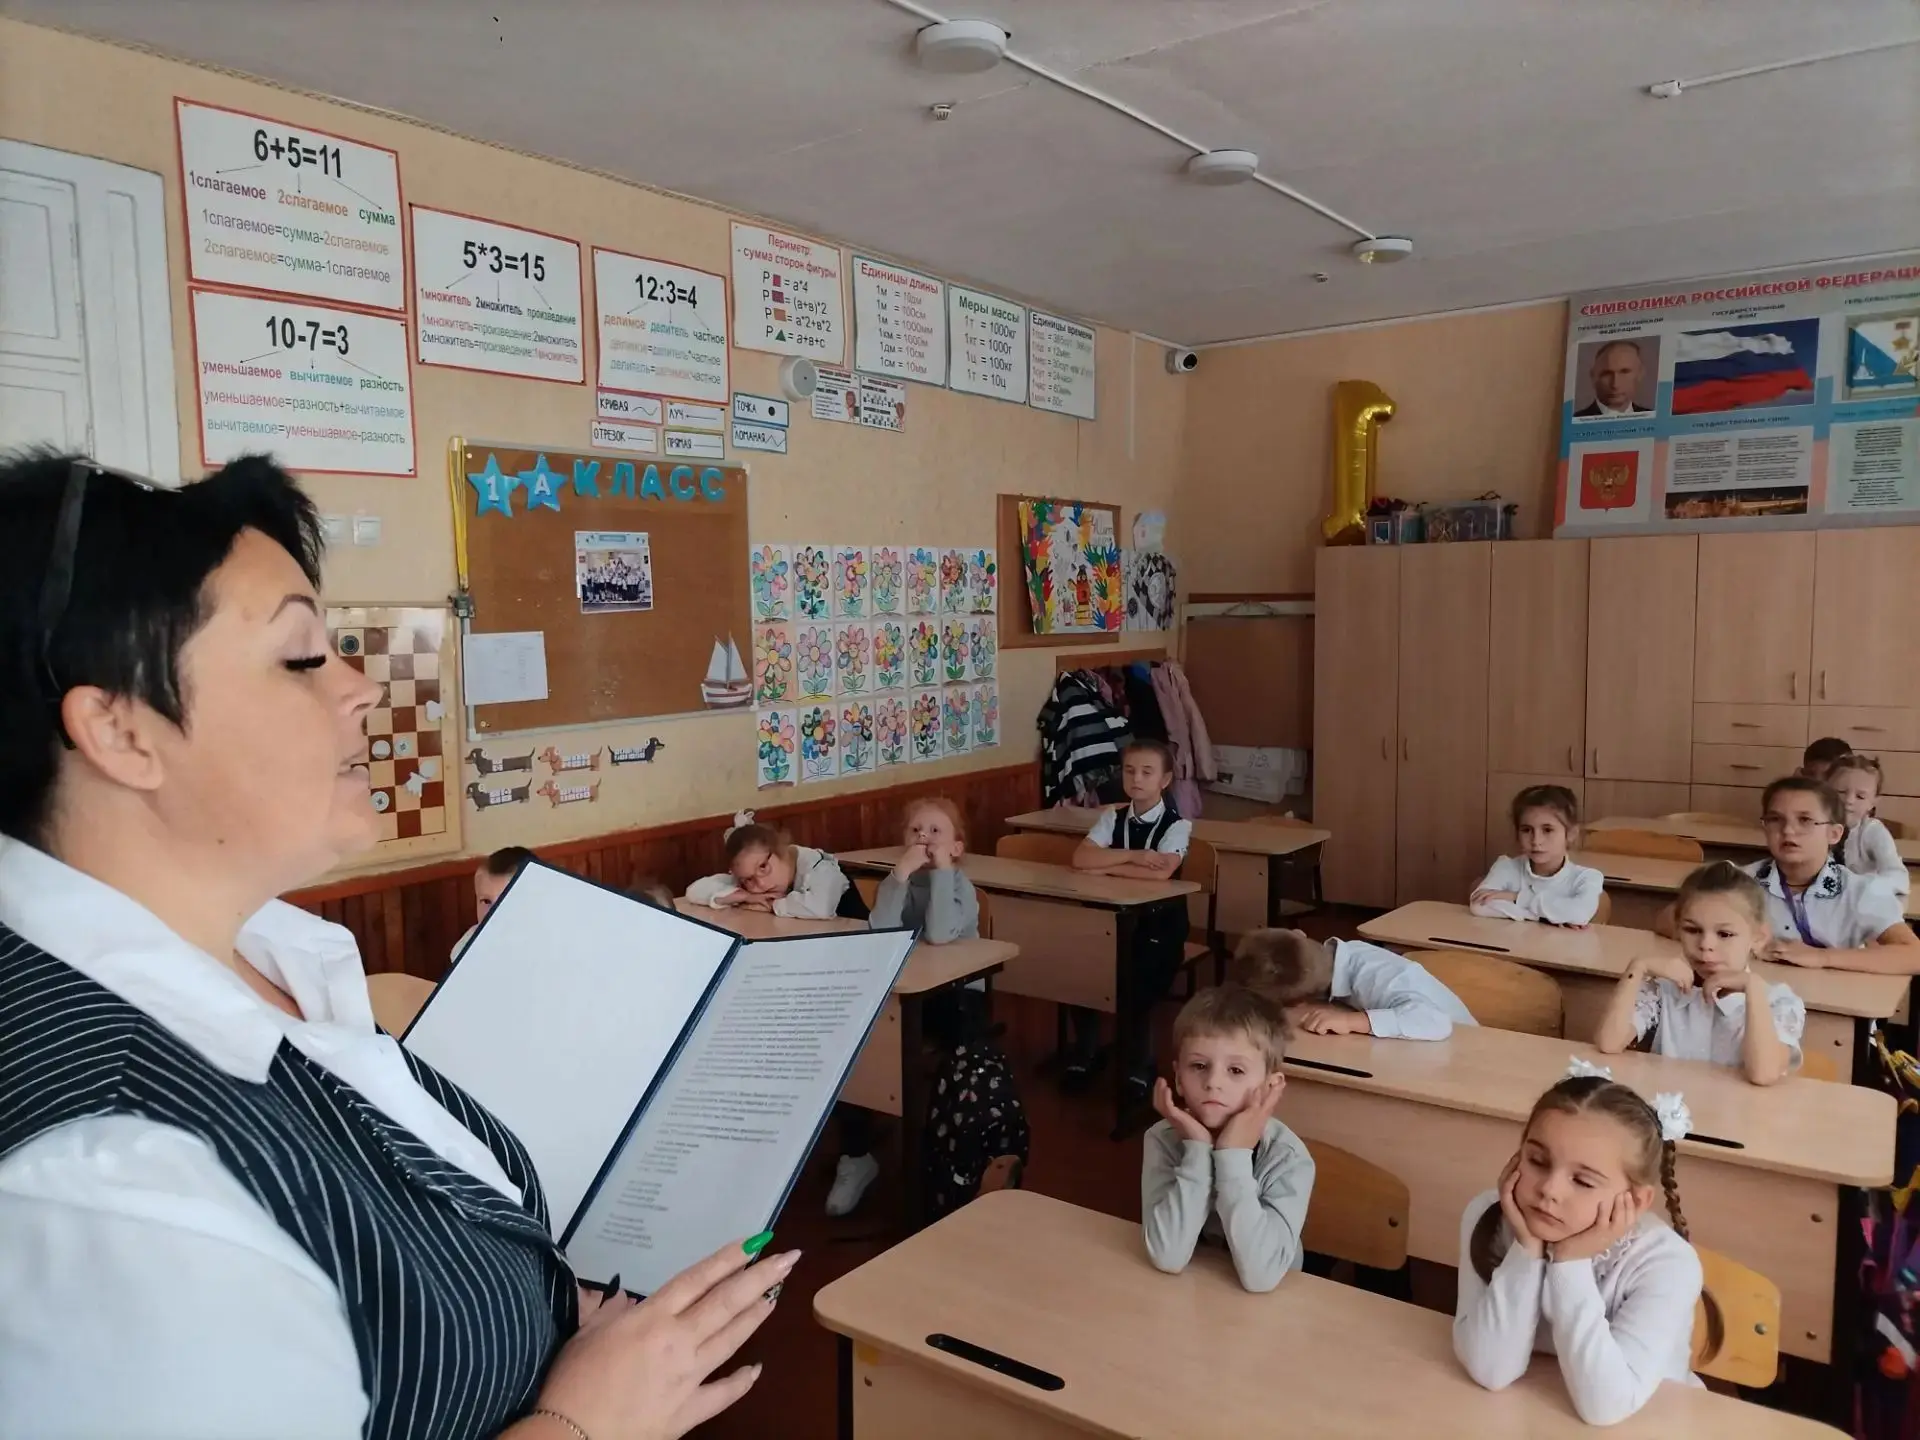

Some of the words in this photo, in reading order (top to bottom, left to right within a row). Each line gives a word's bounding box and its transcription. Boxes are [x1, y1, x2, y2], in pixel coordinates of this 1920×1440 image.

[254, 129, 342, 178] 6+5=11
[189, 170, 266, 200] 1слагаемое
[277, 189, 348, 216] 2слагаемое
[359, 208, 396, 225] сумма
[743, 247, 773, 261] сумма
[775, 255, 804, 269] сторон
[806, 261, 837, 279] фигуры
[861, 263, 907, 287] Единицы
[909, 279, 939, 295] длины
[635, 274, 698, 309] 12:3=4
[876, 285, 887, 296] 1м
[1580, 294, 1687, 316] СИМВОЛИКА
[1691, 278, 1811, 305] РОССИЙСКОЙ
[421, 288, 471, 307] 1множитель
[476, 296, 523, 316] 2множитель
[527, 308, 576, 325] произведение
[877, 299, 887, 310] 1м
[903, 306, 926, 319] 100см
[959, 295, 989, 315] Меры
[992, 306, 1020, 324] массы
[604, 313, 646, 330] делимое
[650, 322, 689, 338] делитель
[693, 330, 725, 345] частное
[878, 314, 888, 325] 1м
[902, 319, 933, 336] 1000мм
[990, 321, 1016, 340] 1000кг
[1033, 314, 1066, 332] Единицы
[266, 316, 349, 355] 10-7=3
[879, 328, 893, 340] 1км
[880, 342, 896, 353] 1дм
[989, 339, 1012, 355] 1000г
[880, 357, 895, 368] 1см
[989, 356, 1013, 371] 100кг
[202, 360, 282, 379] уменьшаемое
[290, 370, 353, 386] вычитаемое
[360, 378, 404, 392] разность
[991, 374, 1006, 389] 10ц
[599, 398, 629, 412] КРИВАЯ
[669, 408, 684, 420] ЛУЧ
[737, 400, 757, 414] ТОЧКА
[594, 427, 626, 441] ОТРЕЗОК
[666, 437, 692, 449] ПРЯМАЯ
[735, 431, 766, 443] ЛОМАНАЯ
[486, 475, 500, 501] 1
[574, 459, 726, 502] КЛАСС
